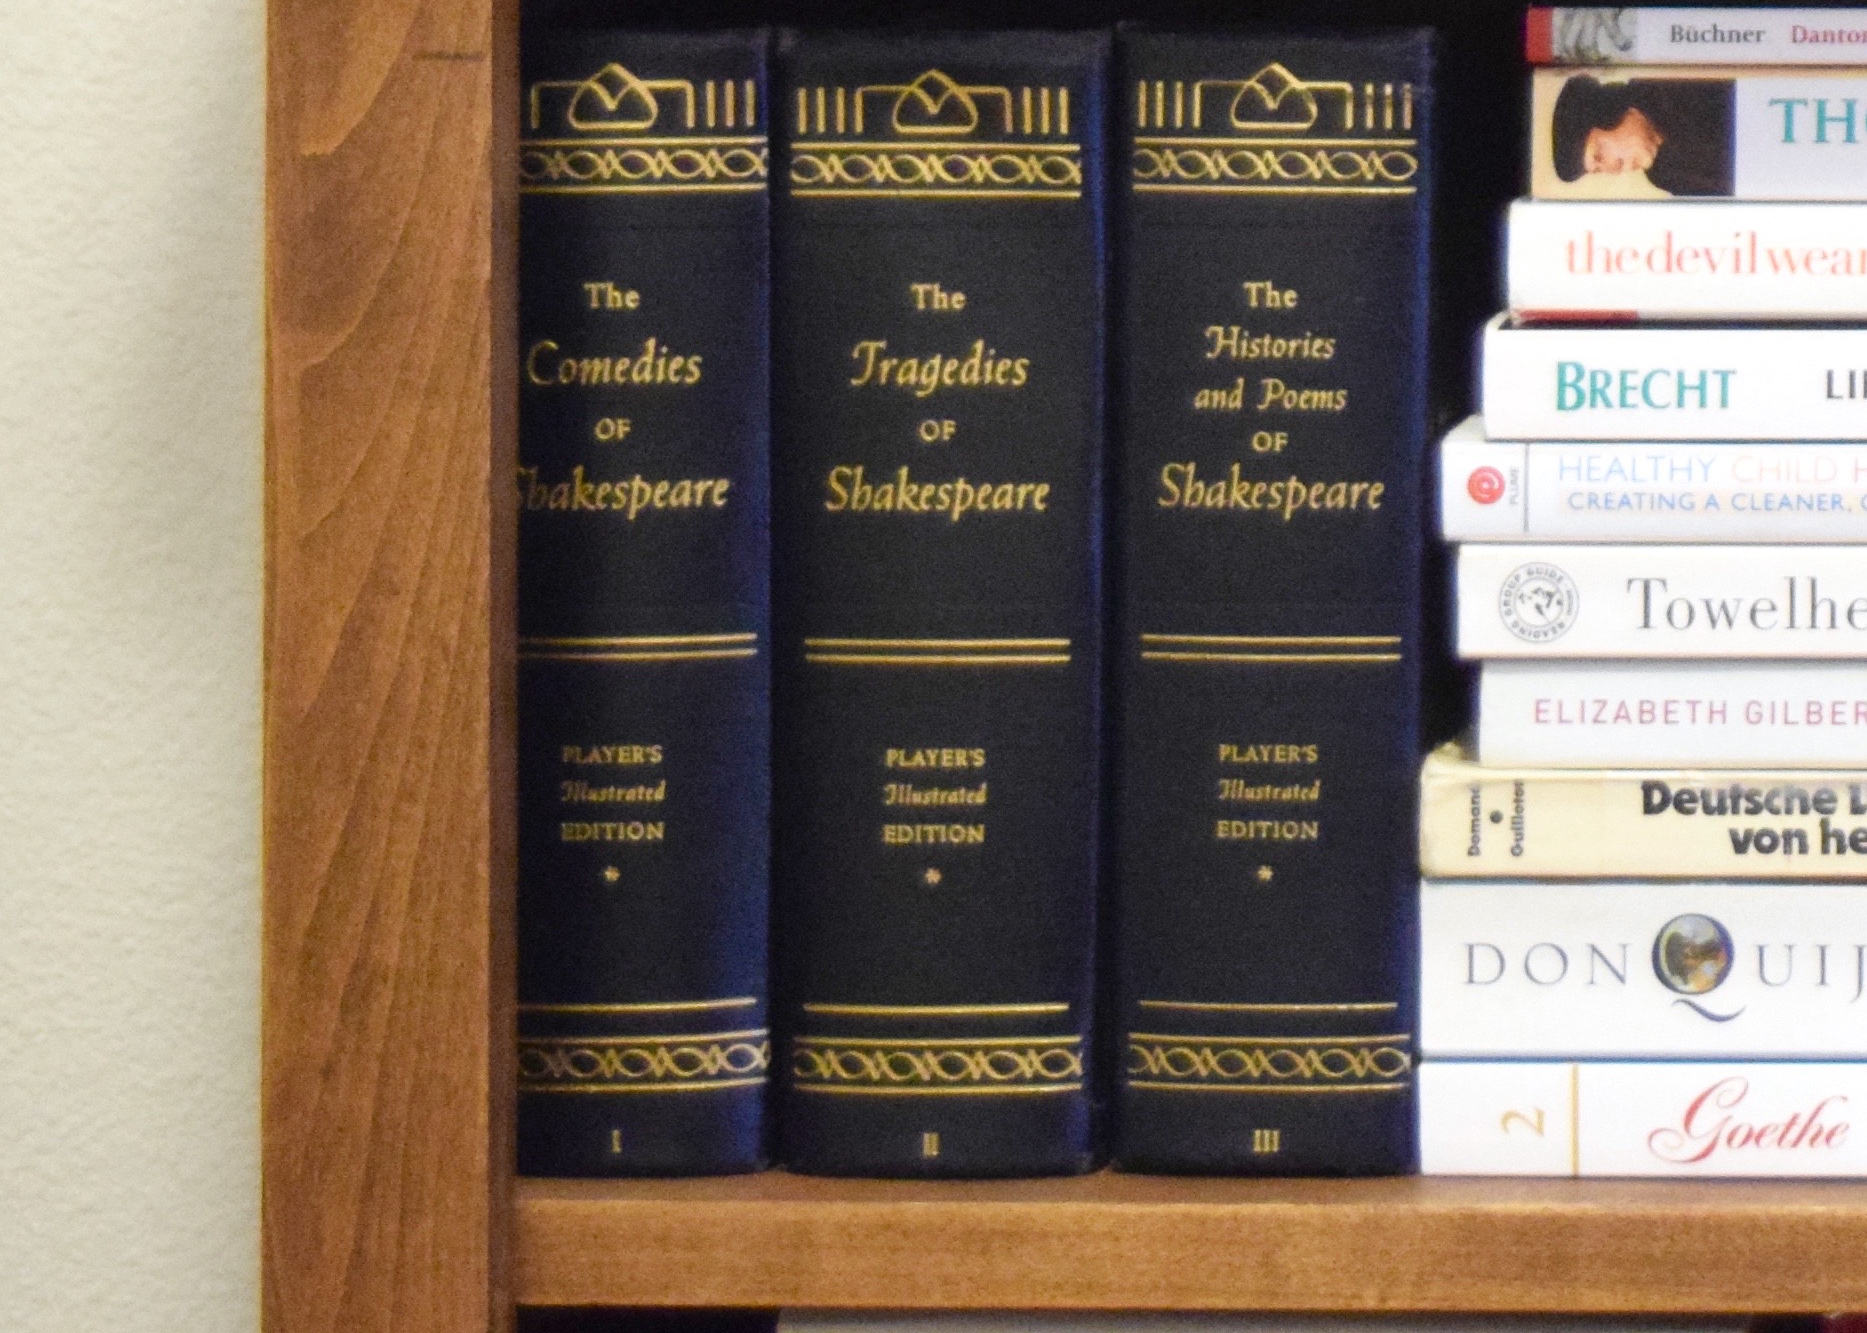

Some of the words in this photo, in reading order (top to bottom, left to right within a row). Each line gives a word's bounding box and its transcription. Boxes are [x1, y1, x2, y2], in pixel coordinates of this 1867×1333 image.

[1669, 25, 1765, 45] Büchner
[1244, 281, 1299, 310] The
[1206, 326, 1336, 361] Histories
[1195, 382, 1244, 411] and
[1257, 378, 1347, 416] Poems
[1252, 431, 1288, 453] OF
[1158, 465, 1384, 518] Shakespeare
[1534, 701, 1728, 725] ELIZABETH
[885, 747, 986, 769] PLAYER'S
[884, 783, 987, 807] Illustrated
[1642, 781, 1838, 818] Deutsche
[883, 822, 985, 844] EDITION
[1728, 825, 1809, 855] von
[1465, 943, 1631, 985] DON
